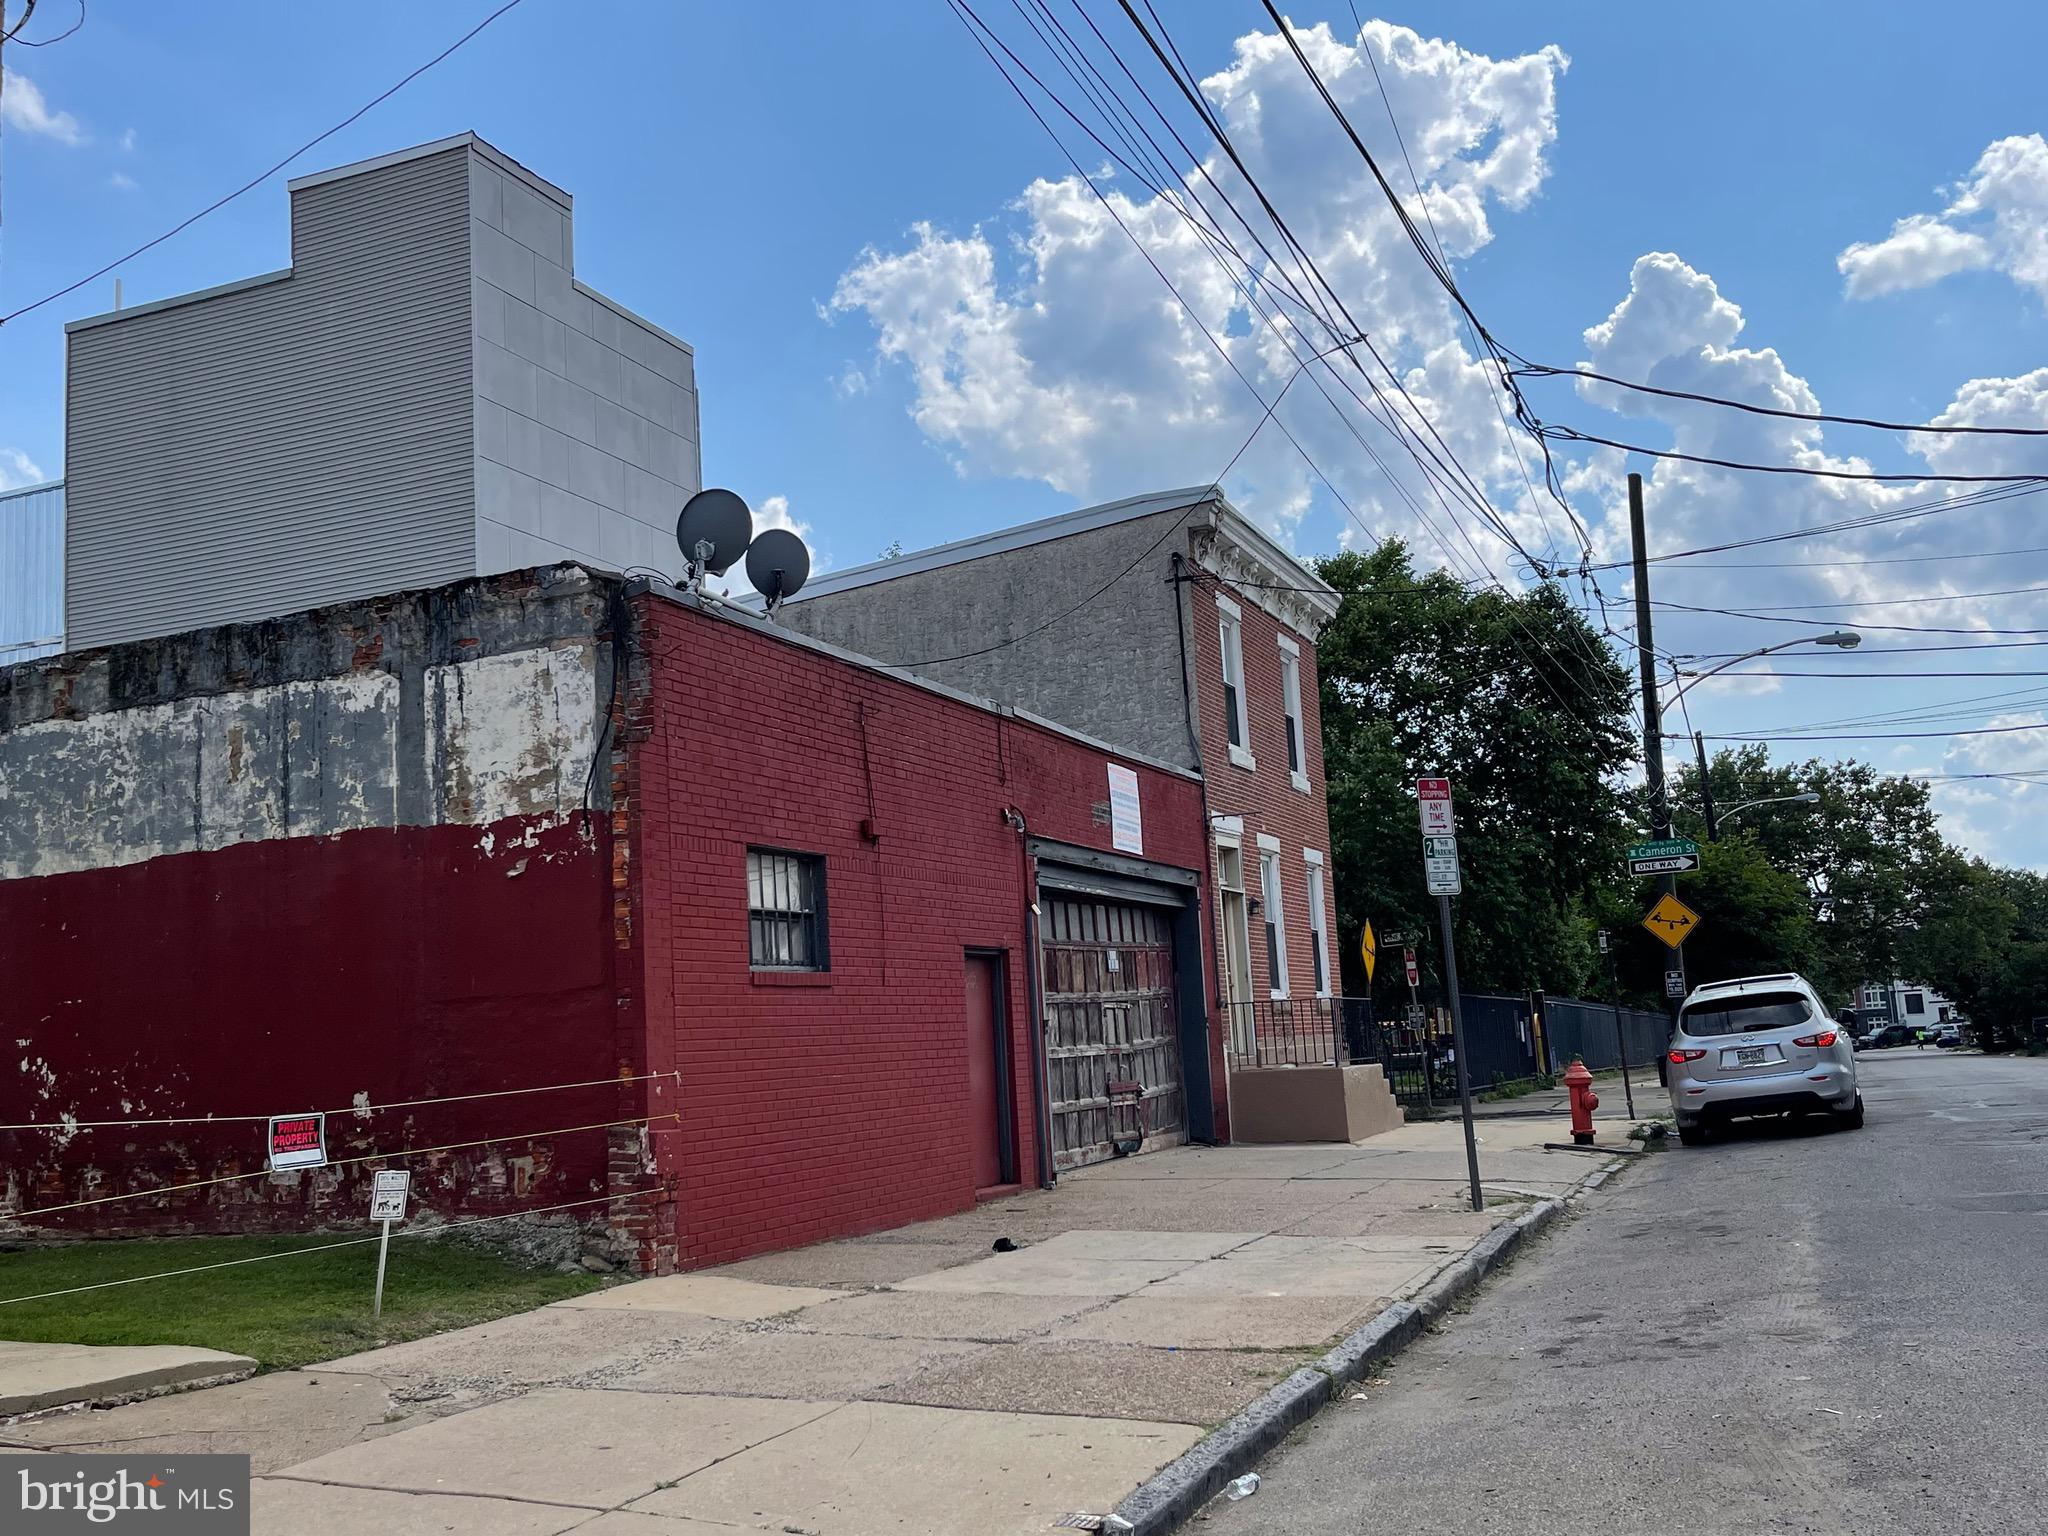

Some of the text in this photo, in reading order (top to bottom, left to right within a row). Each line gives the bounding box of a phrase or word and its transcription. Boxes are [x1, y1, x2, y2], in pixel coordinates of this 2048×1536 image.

[1421, 790, 1448, 799] STOPPING
[1429, 802, 1442, 811] ANY
[1429, 812, 1445, 821] TIME
[1426, 841, 1433, 855] 2
[1434, 848, 1456, 856] PARKING
[1638, 845, 1682, 857] Cameron
[1685, 843, 1696, 853] St
[1638, 860, 1679, 871] ONE WAY
[278, 1120, 315, 1134] PRIVATE
[274, 1131, 318, 1146] PROPERTY
